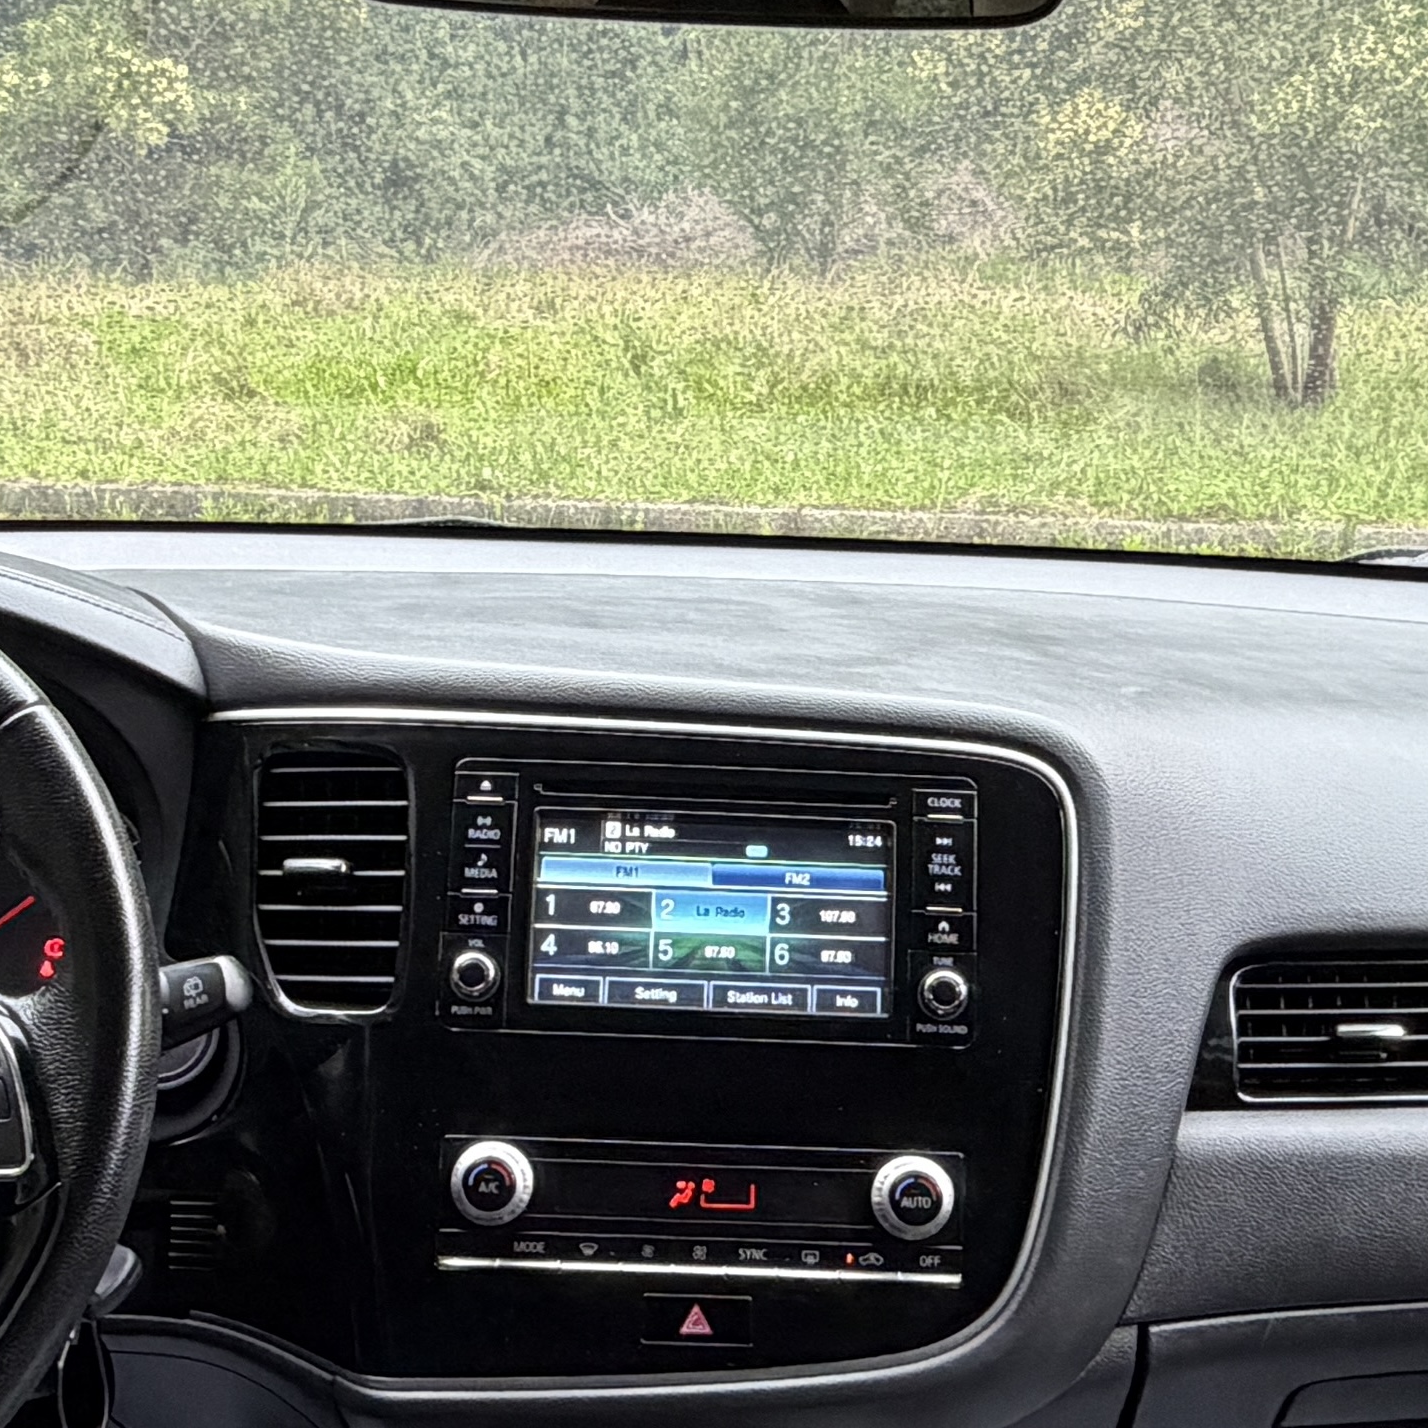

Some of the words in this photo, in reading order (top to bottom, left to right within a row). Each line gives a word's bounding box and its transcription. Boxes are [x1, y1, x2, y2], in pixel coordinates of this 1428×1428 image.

[927, 797, 962, 808] CLOCK
[468, 829, 501, 840] RADIO
[543, 827, 576, 844] FM1
[625, 824, 641, 837] La
[643, 824, 676, 839] Radio
[604, 840, 622, 853] NO
[625, 841, 650, 854] PTY
[848, 834, 883, 847] 15:24
[931, 853, 956, 864] SEEK
[464, 868, 498, 879] MEDIA
[615, 865, 639, 878] FM1
[928, 864, 962, 876] TRACK
[784, 872, 811, 886] FM2
[545, 893, 556, 916] 1
[660, 898, 675, 920] 2
[695, 905, 710, 916] La
[715, 906, 745, 918] Radio
[458, 913, 498, 925] SETTING
[775, 902, 791, 925] 3
[540, 933, 558, 956] 4
[927, 932, 959, 945] HOME
[657, 938, 673, 961] 5
[774, 942, 790, 965] 6
[552, 983, 585, 998] Menu
[634, 985, 678, 1004] Setting
[727, 989, 769, 1005] Station
[771, 991, 793, 1006] List
[835, 993, 859, 1008] Info
[478, 1181, 500, 1195] A/C
[900, 1195, 932, 1210] AUTO
[513, 1239, 546, 1254] MODE
[738, 1246, 769, 1262] SYNC
[919, 1254, 942, 1268] OFF
